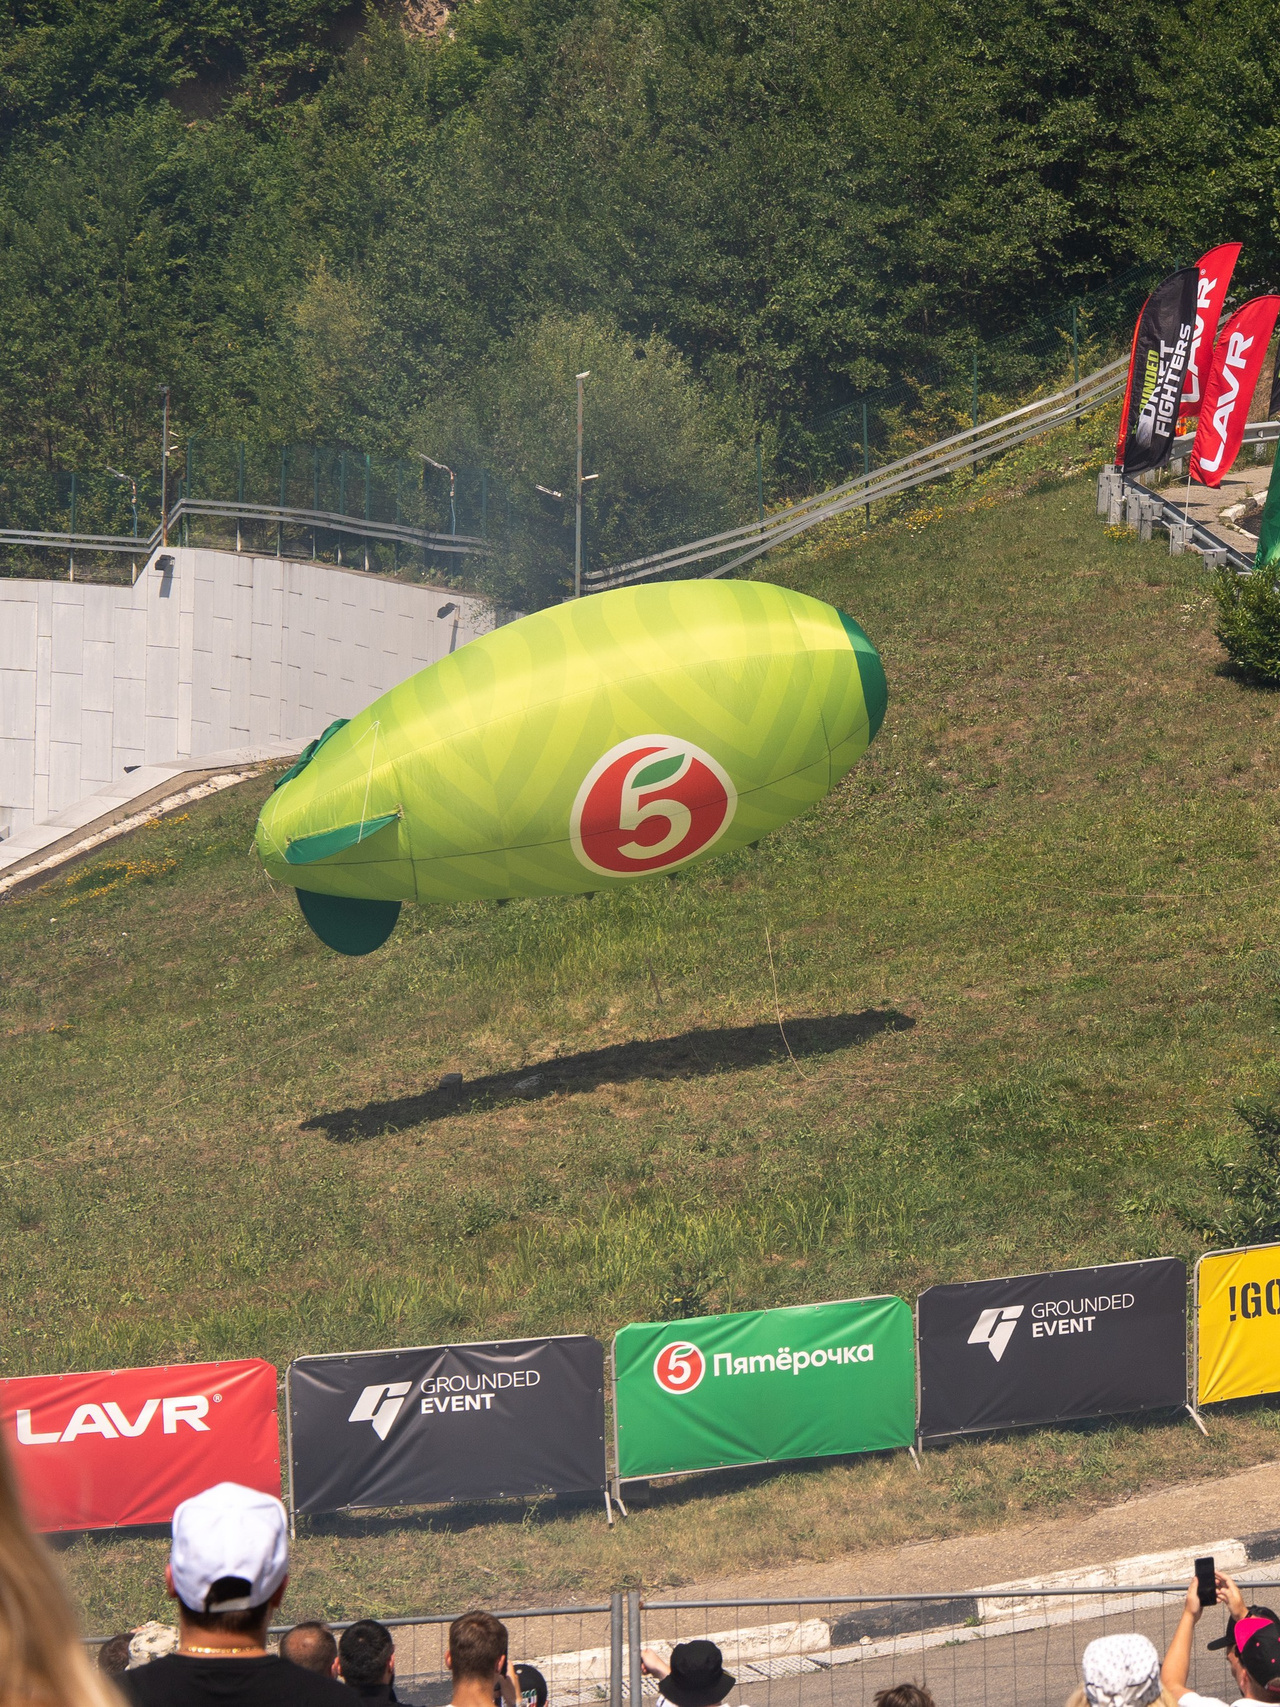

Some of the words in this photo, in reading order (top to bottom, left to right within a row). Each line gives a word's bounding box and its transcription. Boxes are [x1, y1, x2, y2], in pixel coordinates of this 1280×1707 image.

[1155, 323, 1191, 438] FIGHTERS
[1031, 1293, 1136, 1319] GROUNDED
[1032, 1316, 1096, 1339] EVENT
[712, 1343, 876, 1378] Пятёрочка
[420, 1369, 541, 1394] GROUNDED
[420, 1392, 496, 1415] EVENT
